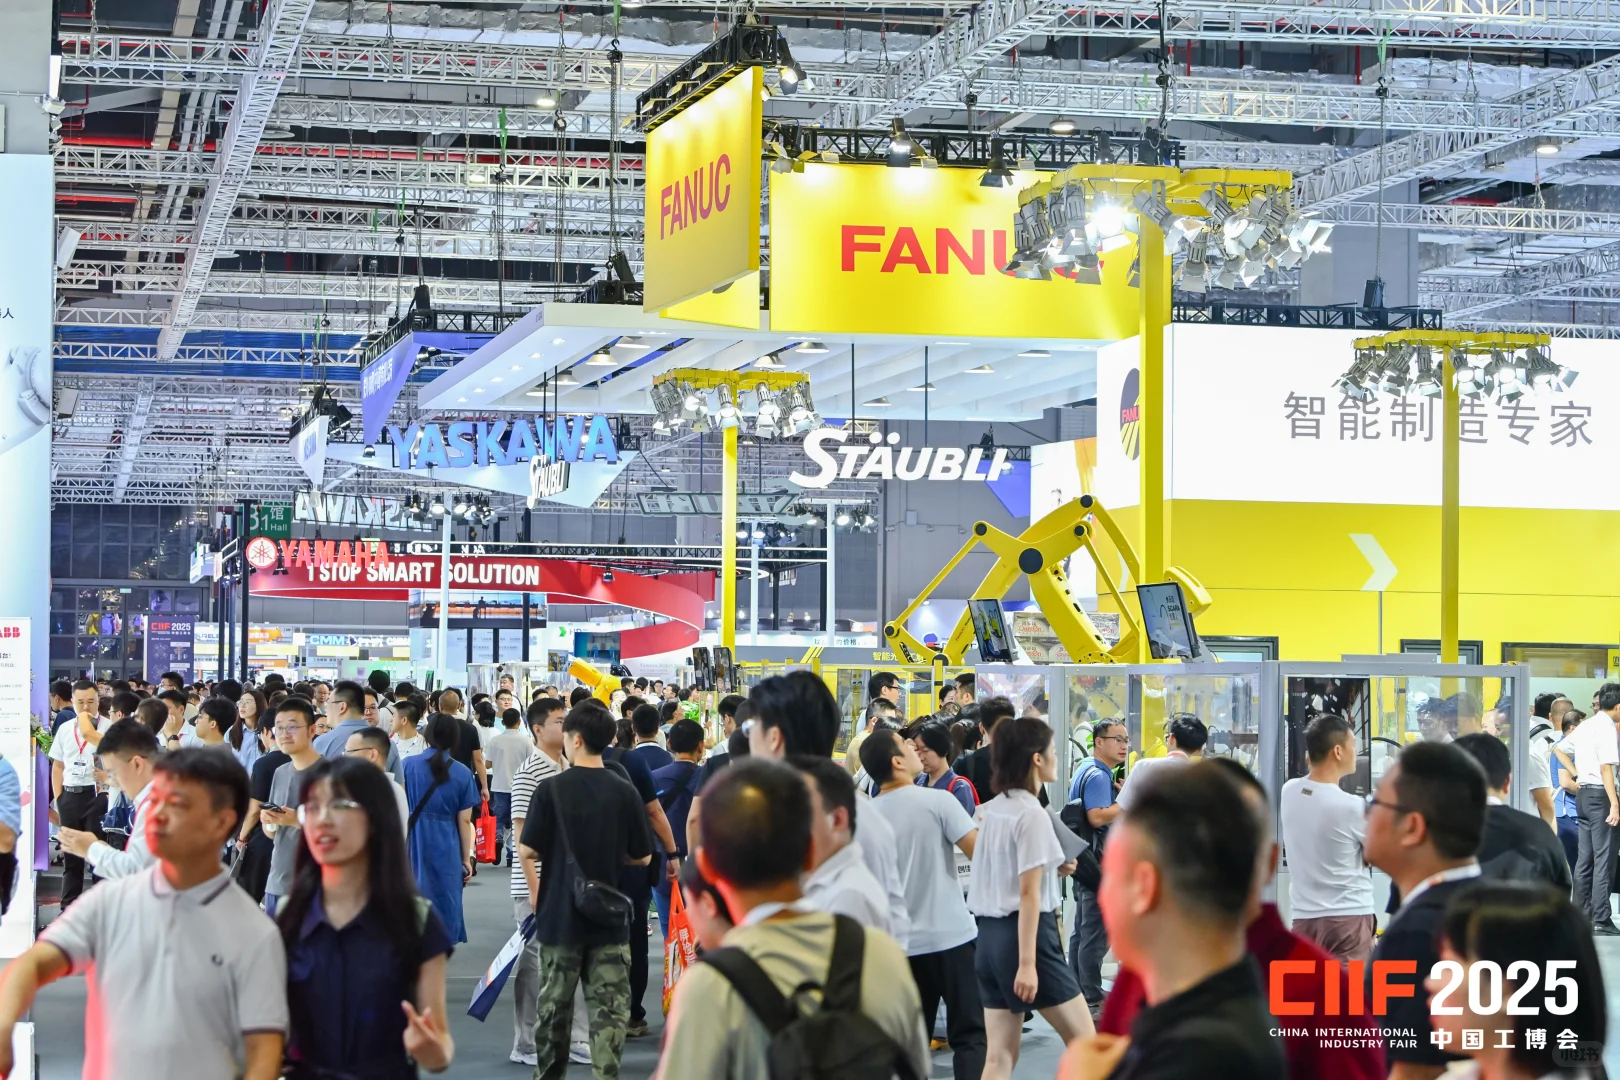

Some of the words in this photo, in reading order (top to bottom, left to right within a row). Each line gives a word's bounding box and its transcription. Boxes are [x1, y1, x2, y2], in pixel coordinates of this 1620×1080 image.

[660, 153, 731, 241] FANUC
[388, 415, 619, 470] YASKAWA
[789, 428, 1008, 488] STÄUBLI
[279, 539, 389, 568] YAMAHA
[320, 562, 361, 581] STOP
[367, 561, 435, 583] SMART
[151, 622, 171, 630] CIIF
[171, 622, 191, 630] 2025
